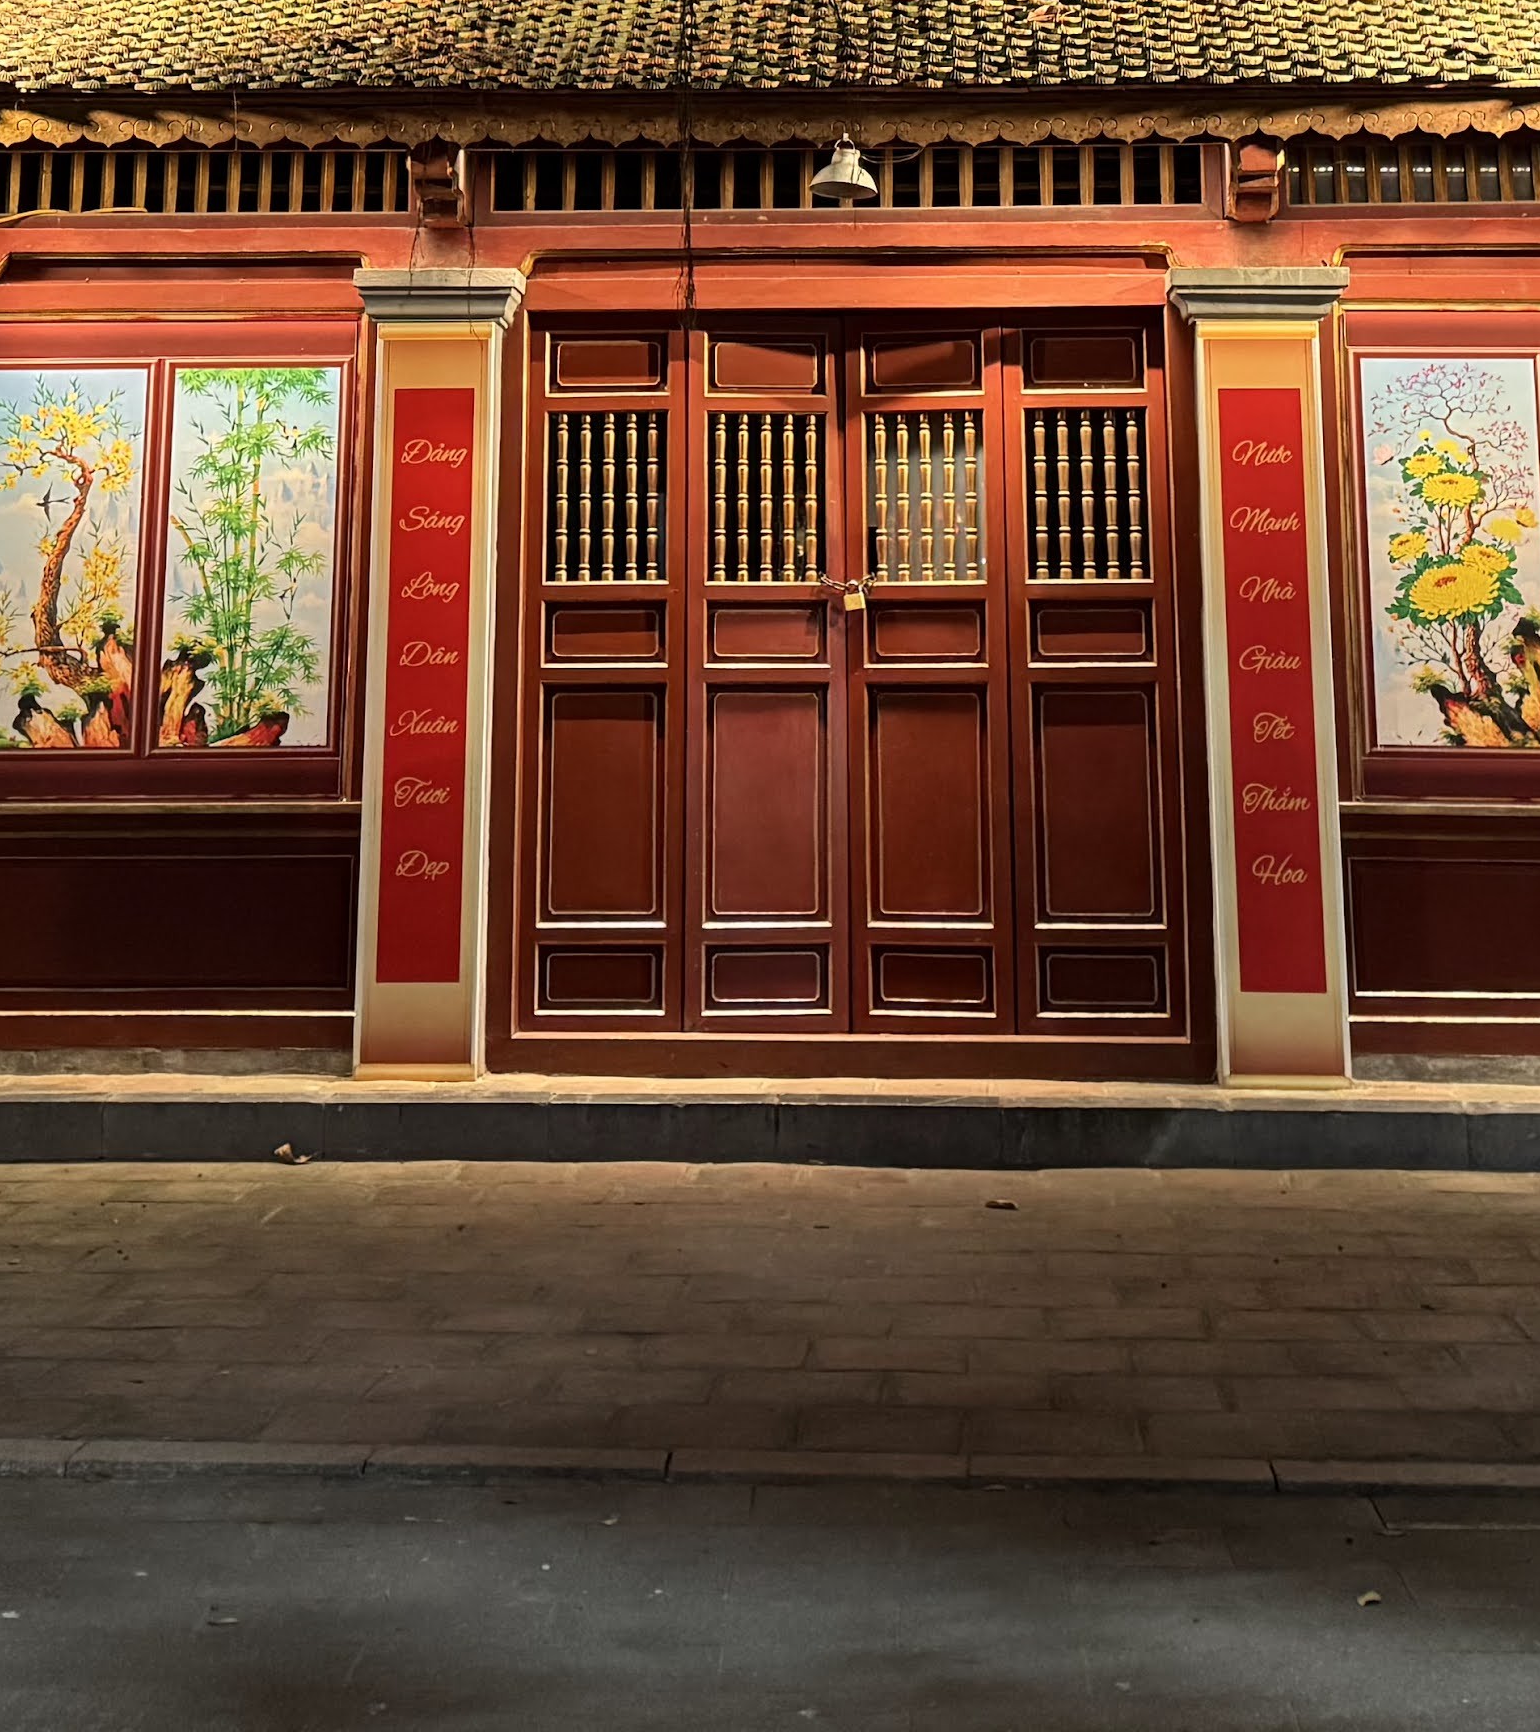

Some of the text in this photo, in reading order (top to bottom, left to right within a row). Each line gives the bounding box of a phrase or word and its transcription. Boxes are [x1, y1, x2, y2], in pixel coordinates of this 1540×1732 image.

[401, 439, 468, 468] Đảng
[1232, 440, 1293, 466] Nước
[399, 506, 466, 535] Sáng
[1229, 506, 1301, 535] Mạnh
[401, 571, 460, 603] Lòng
[1239, 576, 1297, 603] Nhà
[399, 641, 459, 667] Dân
[1239, 645, 1302, 674] Giàu
[389, 708, 458, 737] Xuân
[1253, 712, 1296, 743] Tết
[394, 776, 450, 808] Tươi
[1242, 783, 1311, 814] Thắm
[395, 849, 450, 881] Đẹp
[1252, 854, 1309, 886] Hoa
